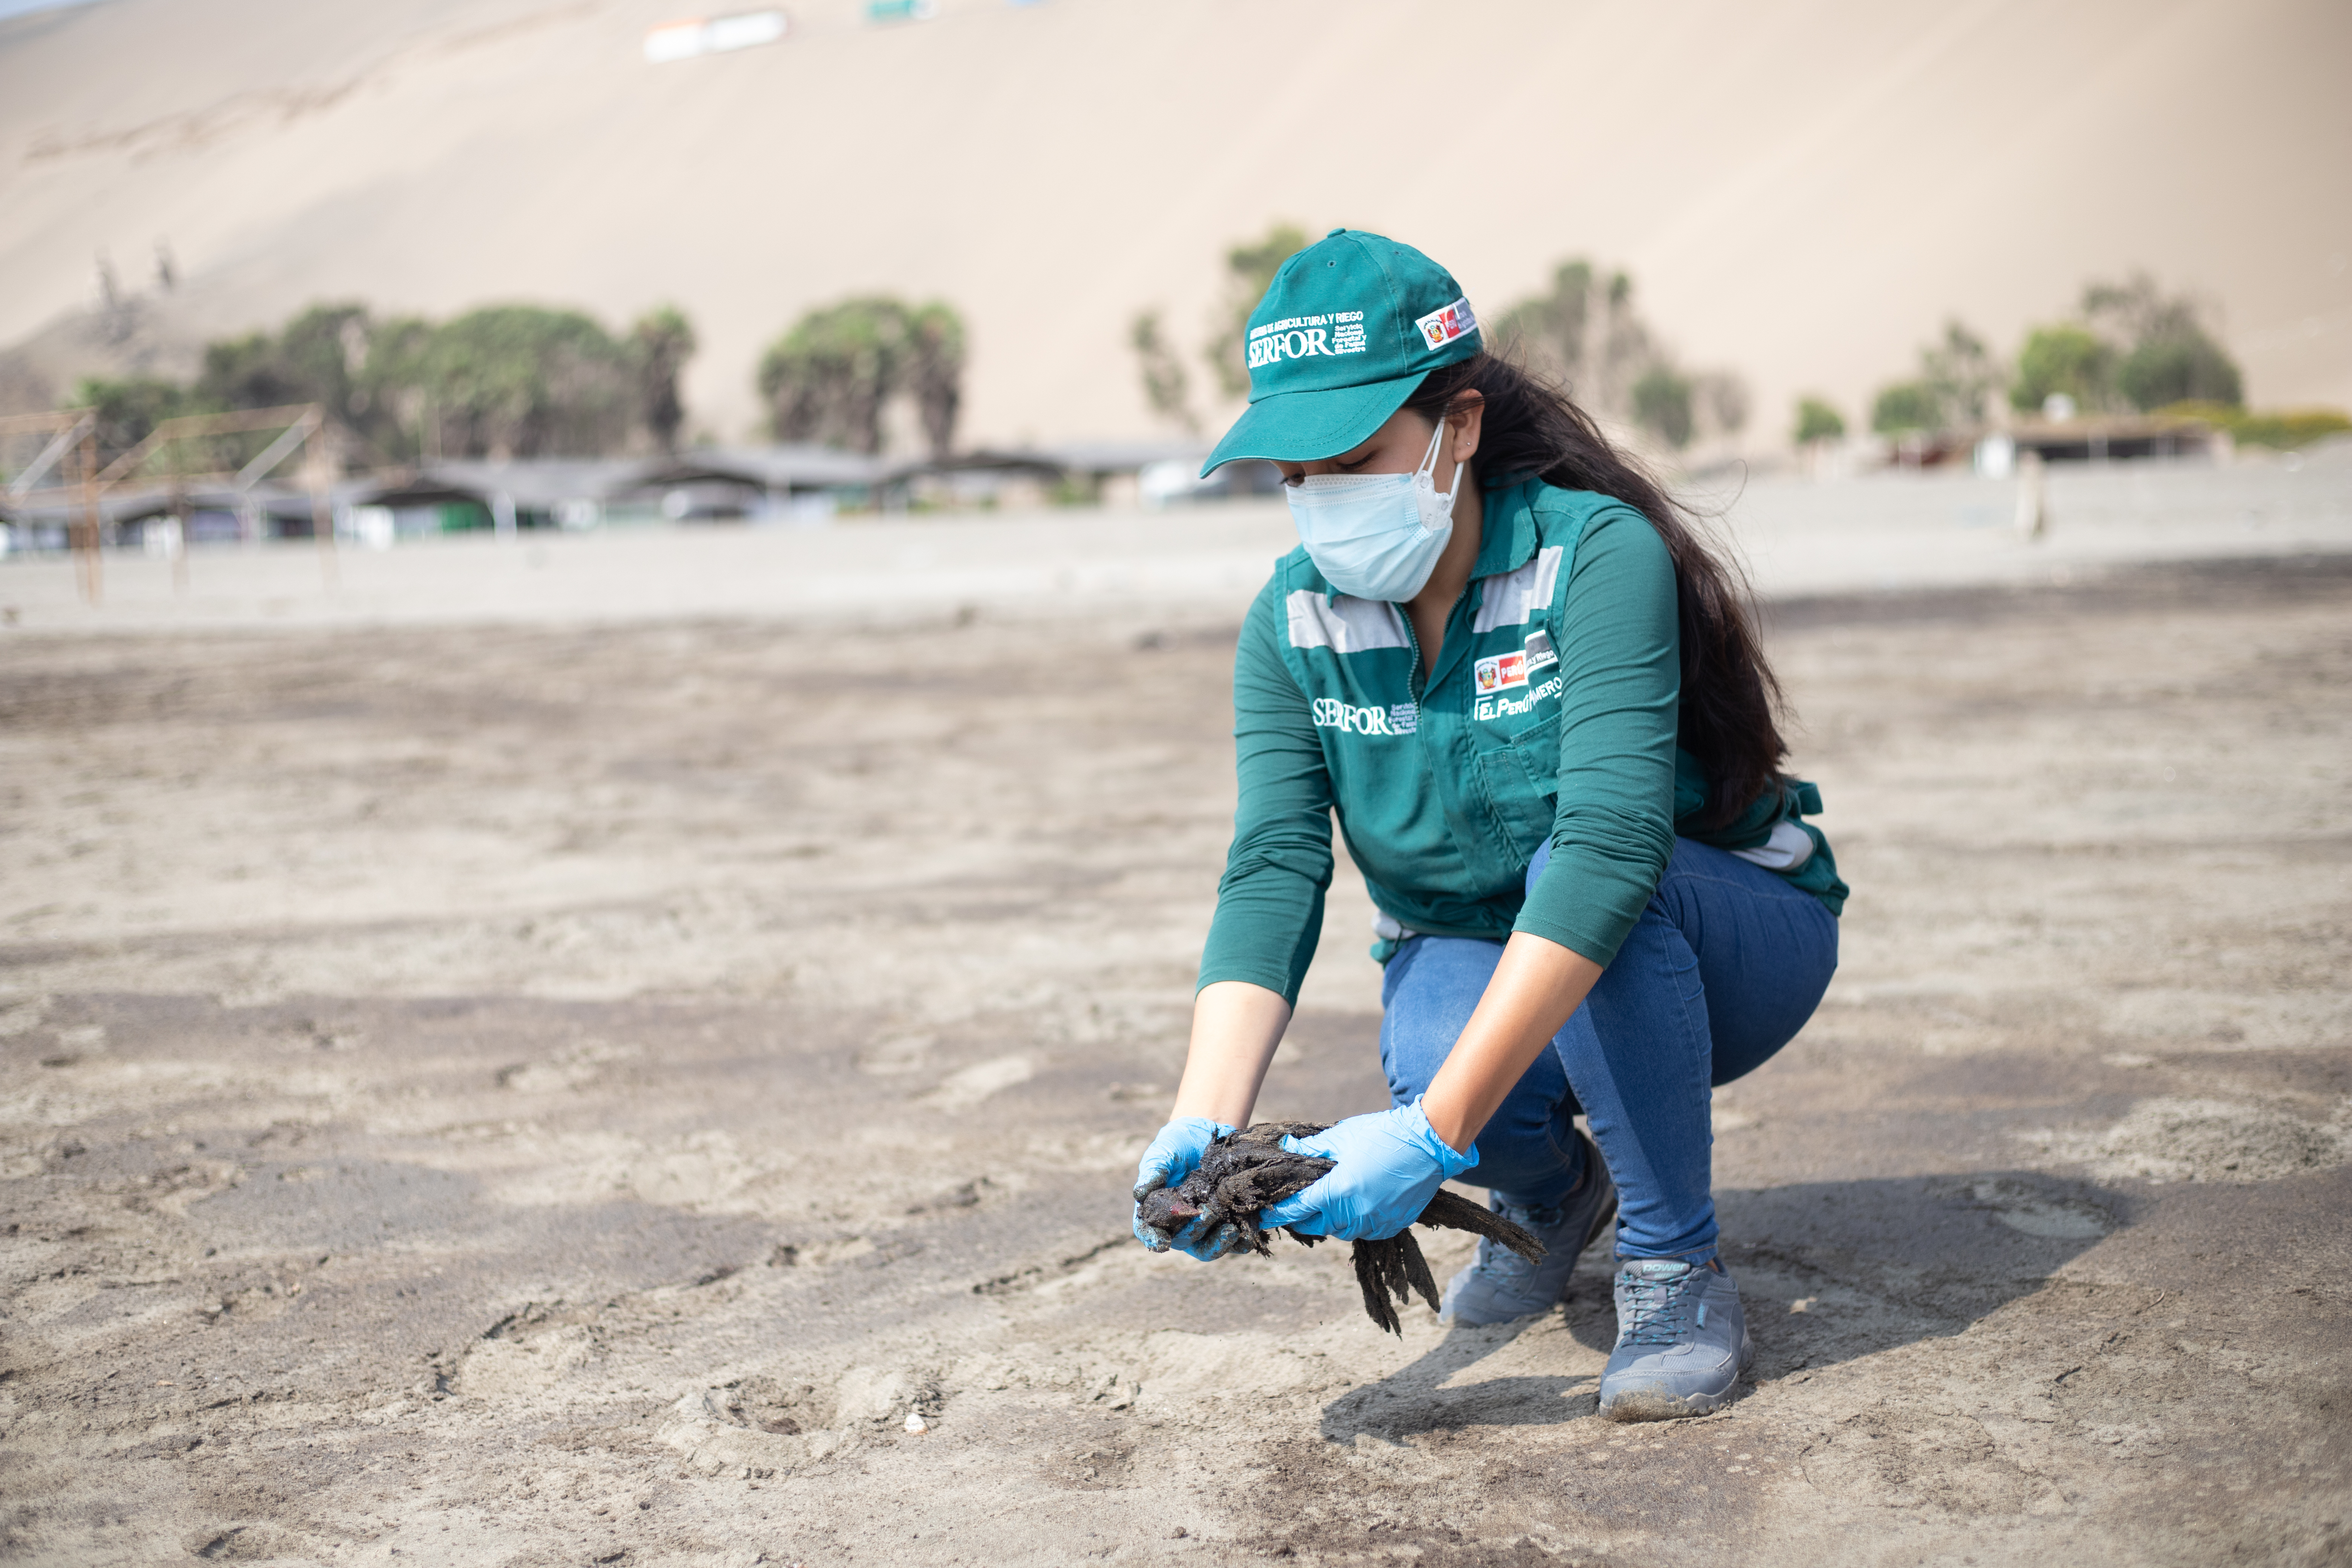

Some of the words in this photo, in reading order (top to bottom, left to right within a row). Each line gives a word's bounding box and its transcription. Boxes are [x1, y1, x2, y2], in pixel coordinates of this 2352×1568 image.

[1274, 314, 1328, 332] AGRICULTURA
[1327, 313, 1334, 324] Y
[1335, 311, 1363, 323] RIEGO
[1332, 334, 1361, 344] Forestal
[1335, 328, 1364, 337] Nacional
[1248, 329, 1335, 369] SERFOR
[1536, 650, 1554, 662] Riego
[1501, 661, 1524, 678] PERÚ
[1479, 702, 1496, 721] EL
[1496, 694, 1530, 718] PERÚ
[1529, 677, 1562, 712] PMERO
[1313, 698, 1394, 735] SERFOR
[1642, 1263, 1687, 1273] power
